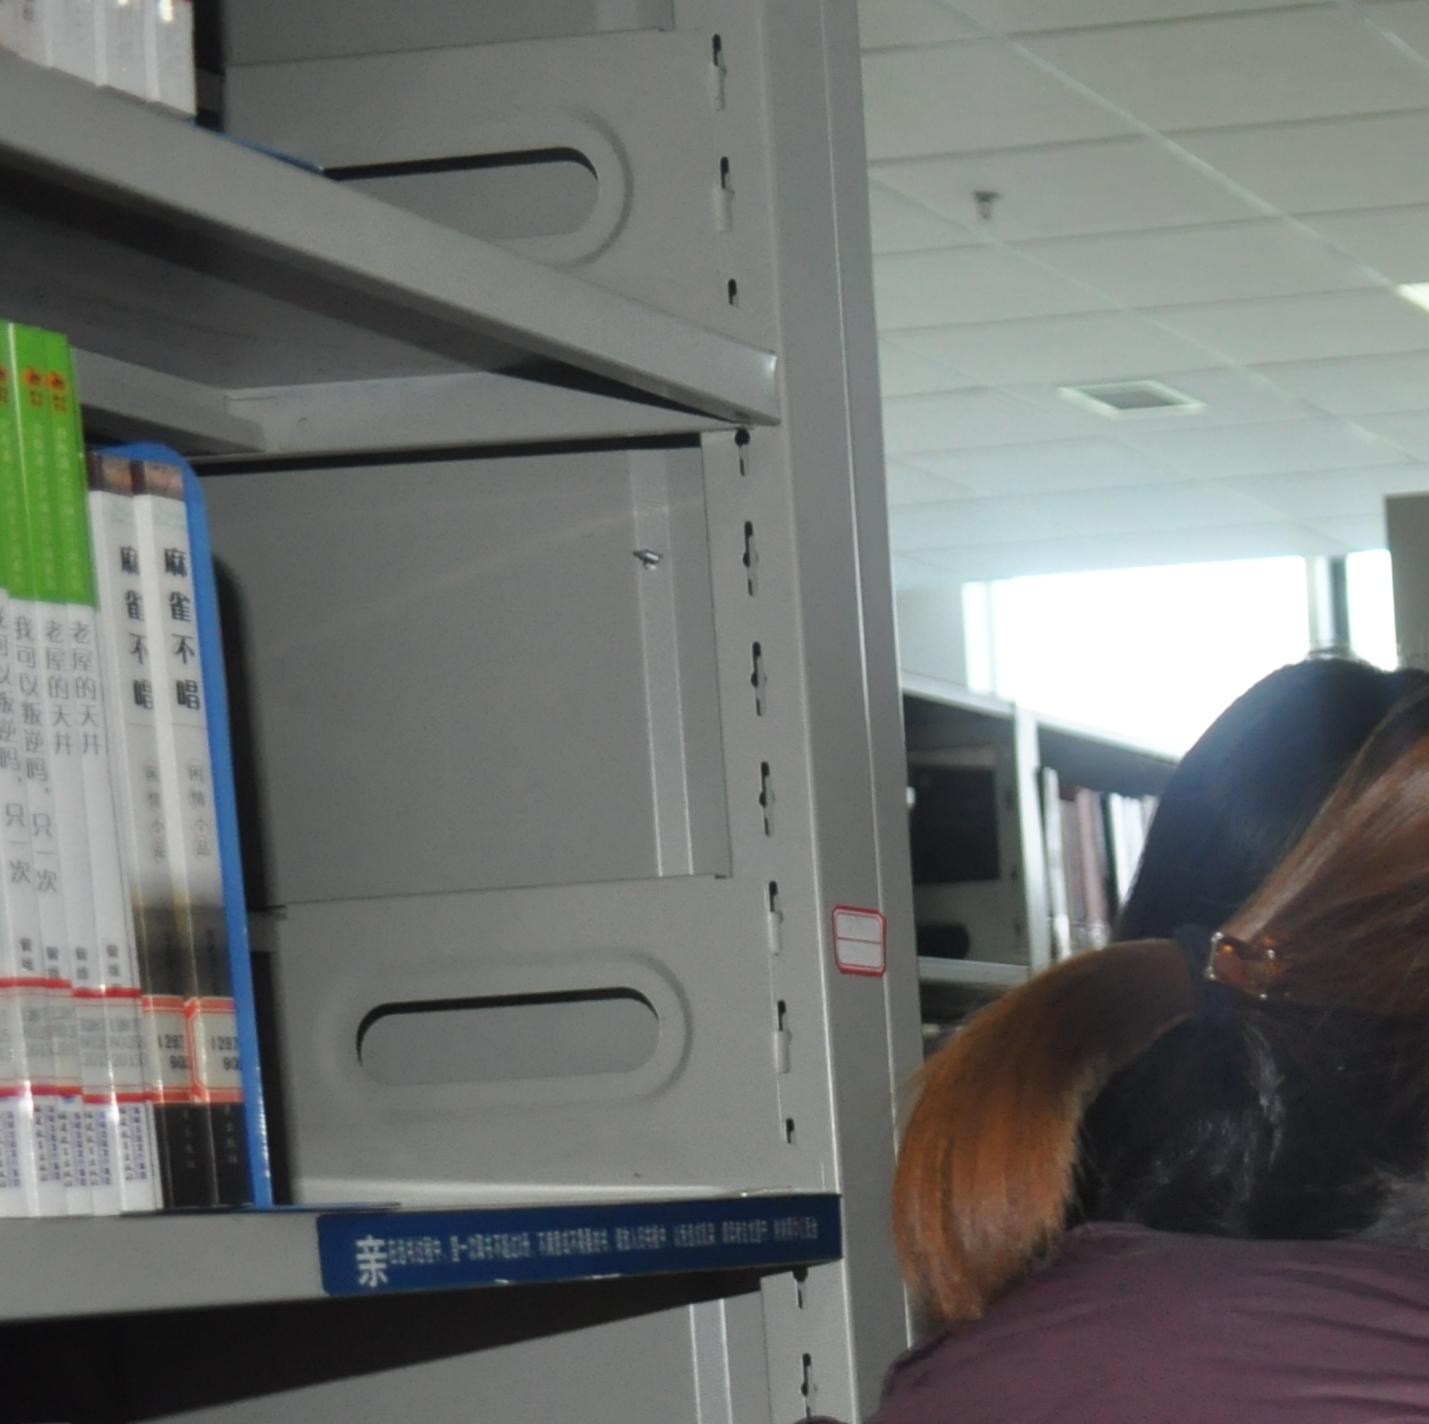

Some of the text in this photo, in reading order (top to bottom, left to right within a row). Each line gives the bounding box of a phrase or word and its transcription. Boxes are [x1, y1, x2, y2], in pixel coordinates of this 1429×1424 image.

[46, 620, 71, 756] 老屋的天井
[72, 620, 99, 756] 老屋的天井
[120, 546, 153, 710] 麻雀不唱
[164, 547, 201, 711] 麻雀不唱
[355, 1234, 389, 1287] 亲
